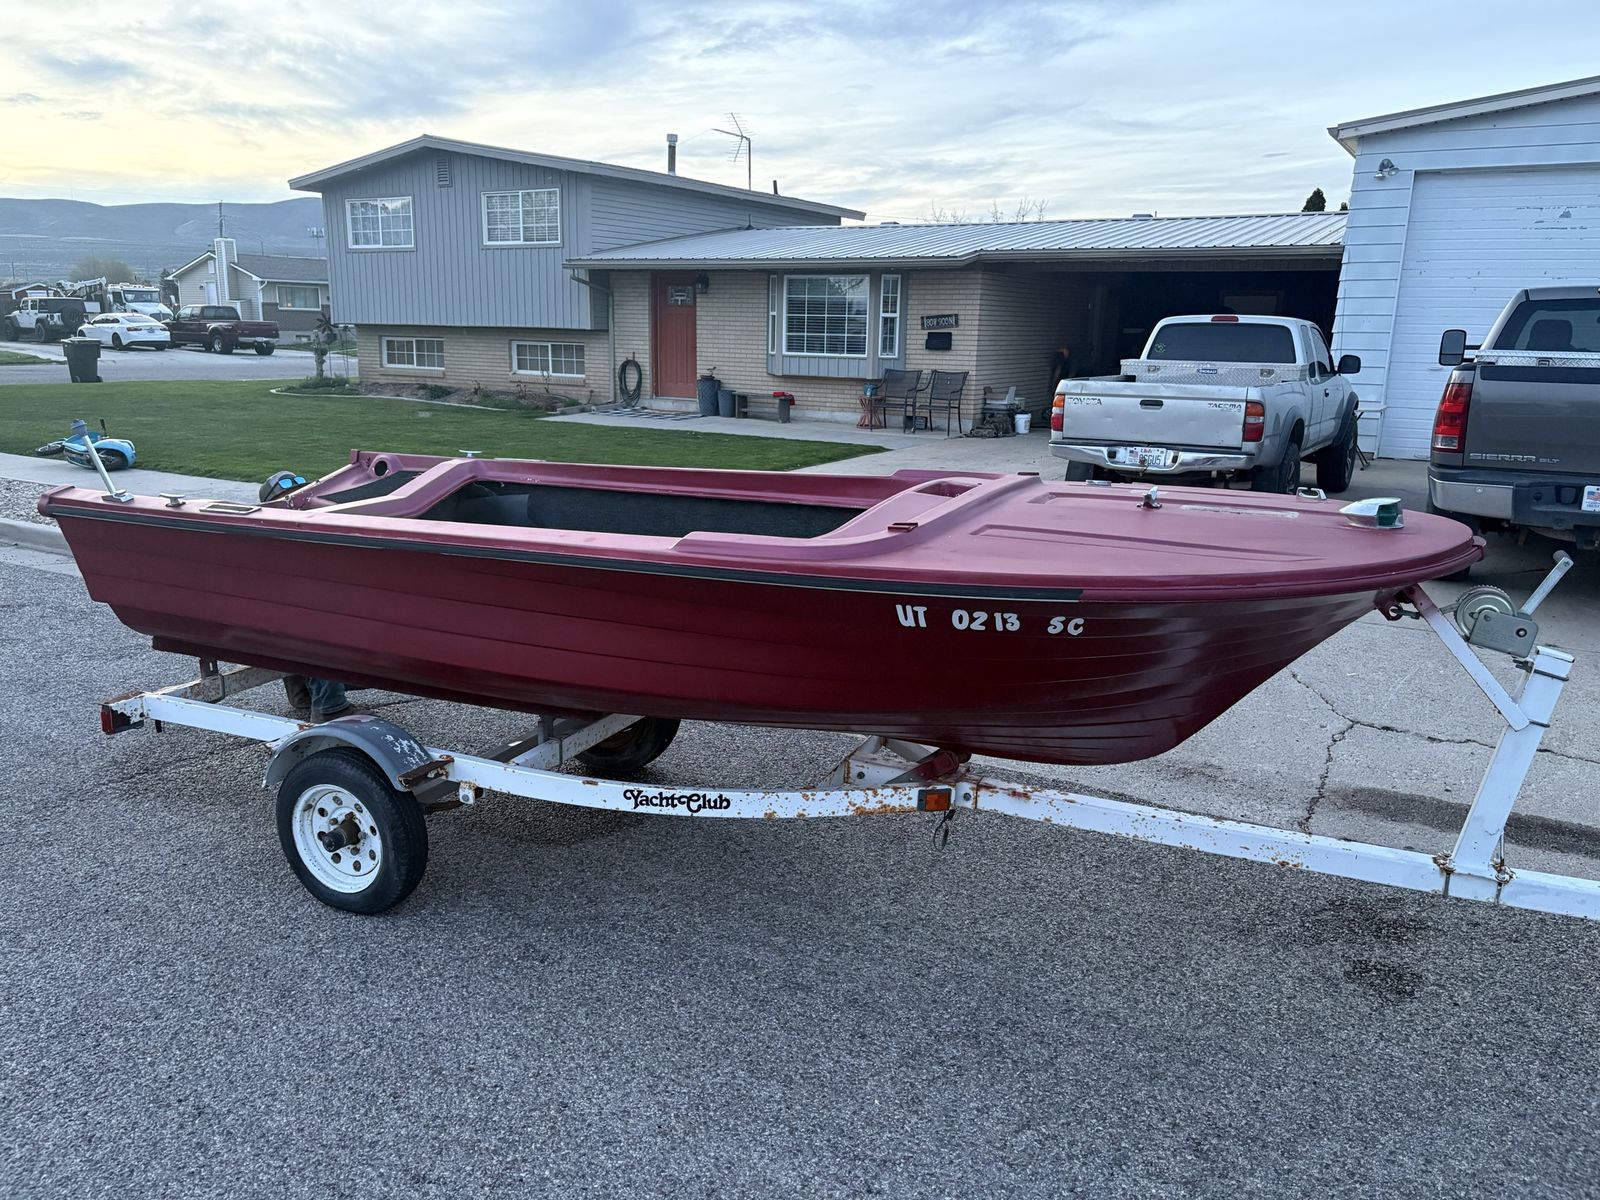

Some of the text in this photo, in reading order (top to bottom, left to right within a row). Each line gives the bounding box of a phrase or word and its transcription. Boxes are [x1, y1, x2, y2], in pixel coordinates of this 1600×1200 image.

[1067, 397, 1103, 405] TOYOTA
[1470, 453, 1536, 462] SIERRA
[896, 604, 1085, 636] UT 0213 SC
[623, 789, 731, 813] Yacht Club
